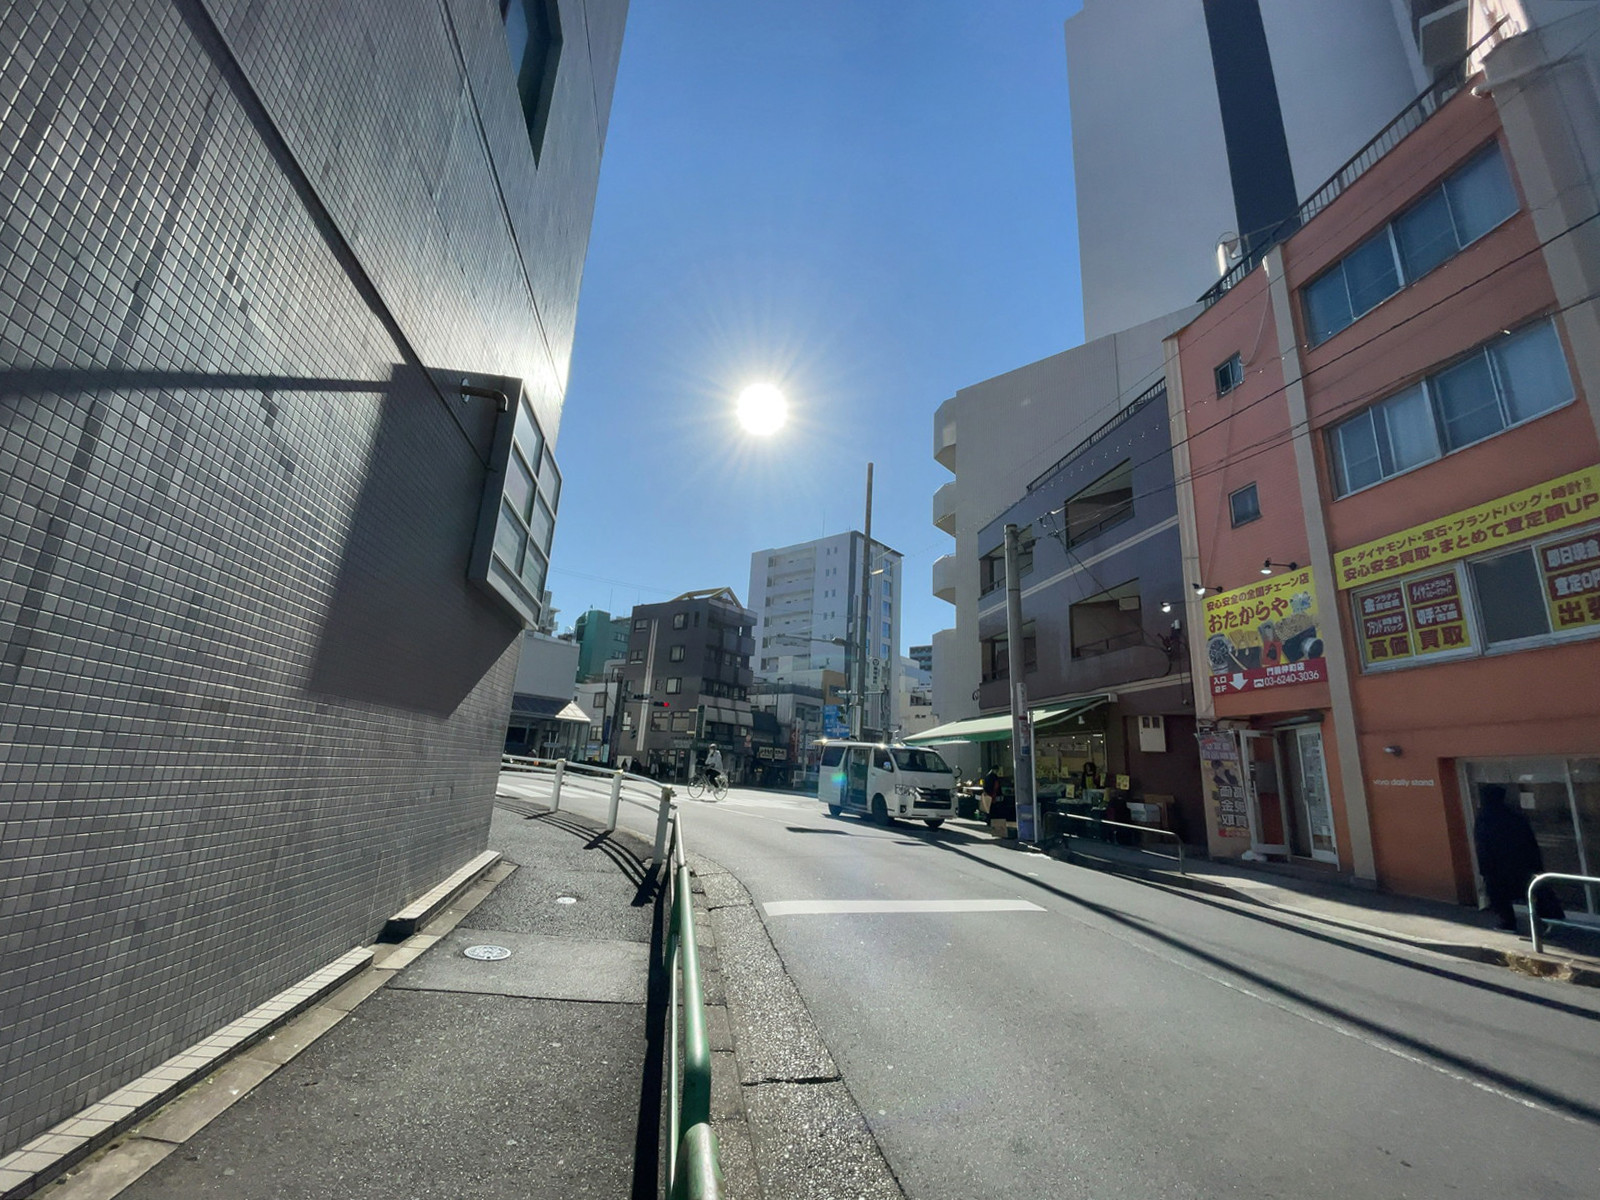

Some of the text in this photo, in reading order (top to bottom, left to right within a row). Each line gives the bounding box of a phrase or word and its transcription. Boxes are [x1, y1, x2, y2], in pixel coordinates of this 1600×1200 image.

[1208, 597, 1289, 633] おたからや
[1264, 670, 1320, 686] 03-6240-3036
